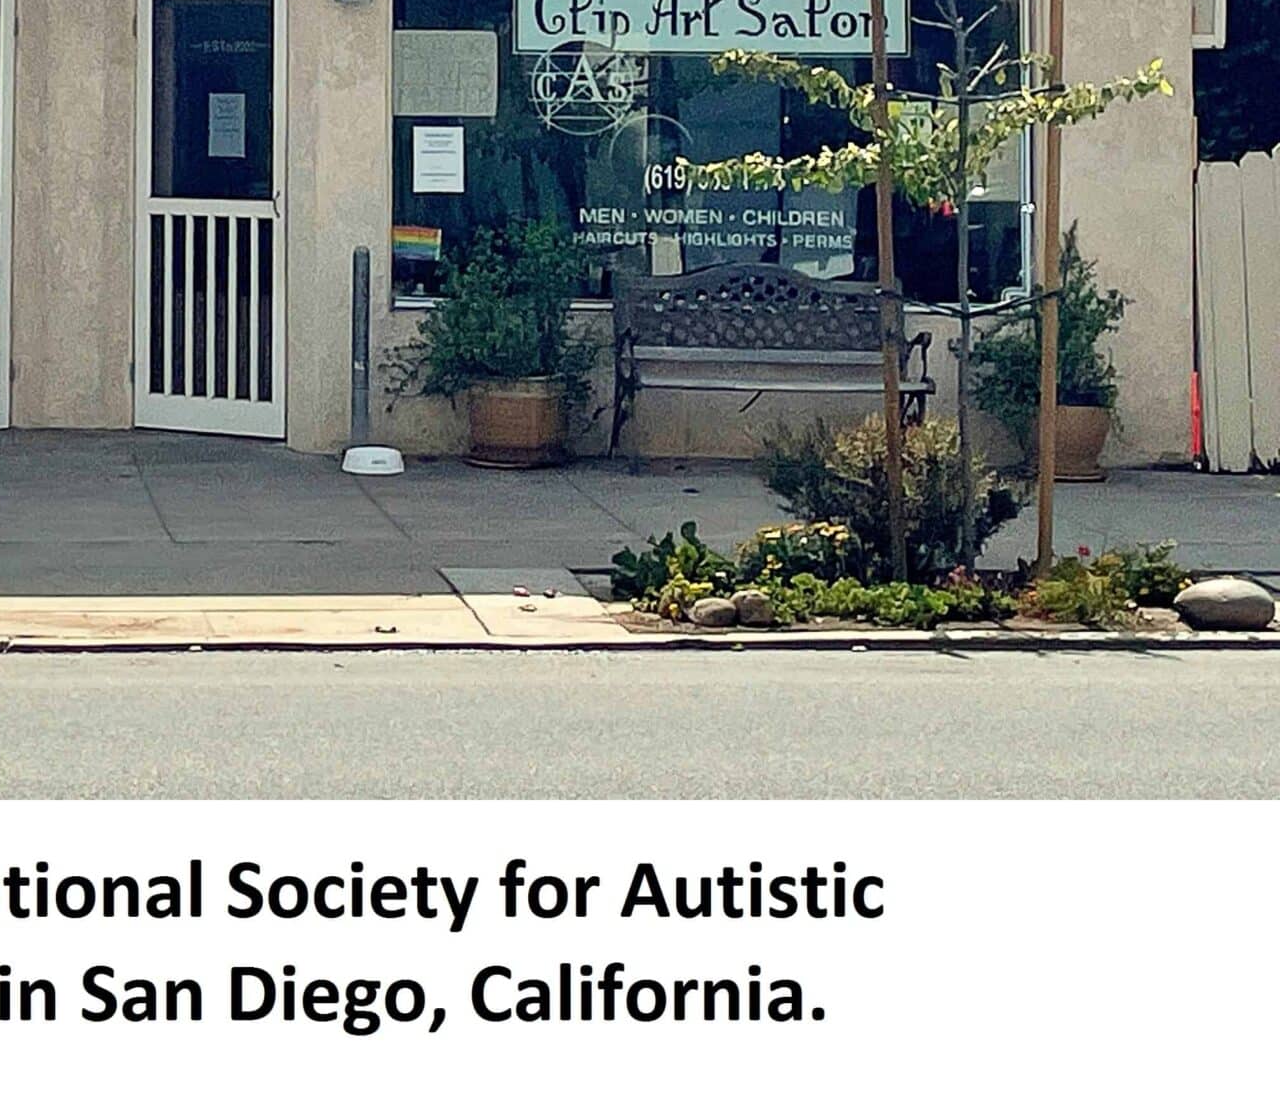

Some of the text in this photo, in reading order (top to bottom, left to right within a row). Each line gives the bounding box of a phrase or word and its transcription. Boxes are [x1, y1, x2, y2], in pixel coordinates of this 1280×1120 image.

[579, 208, 844, 227] MEN WOMEN CHILDREN
[573, 232, 852, 249] HAIRCUTS HIGHLIGHTS PERMS
